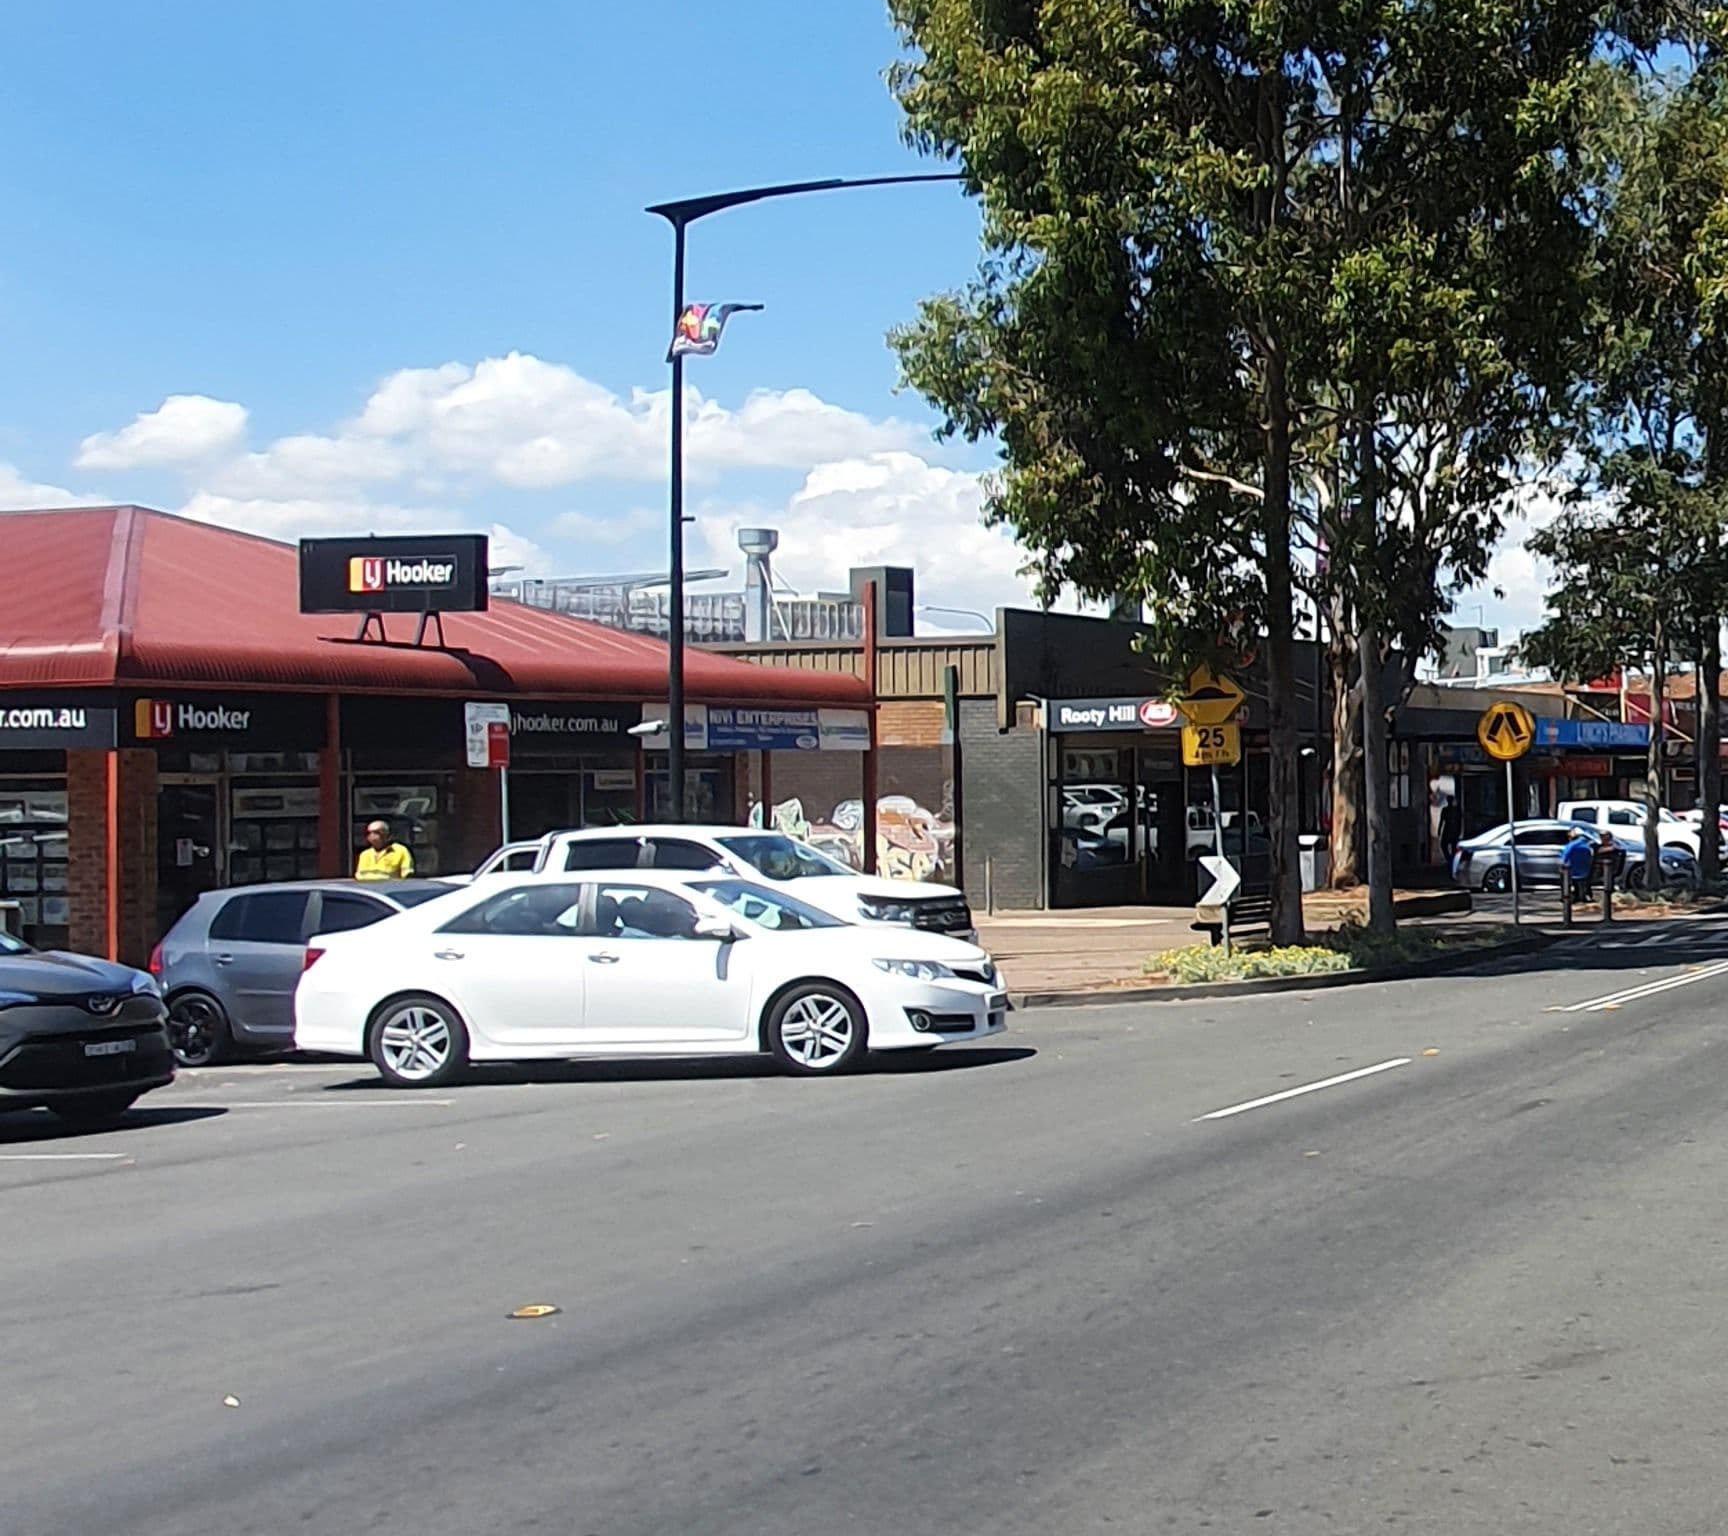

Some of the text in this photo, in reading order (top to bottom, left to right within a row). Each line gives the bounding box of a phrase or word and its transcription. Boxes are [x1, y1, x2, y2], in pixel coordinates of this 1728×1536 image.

[386, 559, 453, 584] Hooker
[178, 704, 250, 729] Hooker
[511, 713, 619, 736] jhooker.com.au
[1061, 707, 1106, 727] Rooty
[1109, 705, 1136, 722] Hill
[1198, 727, 1226, 749] 25
